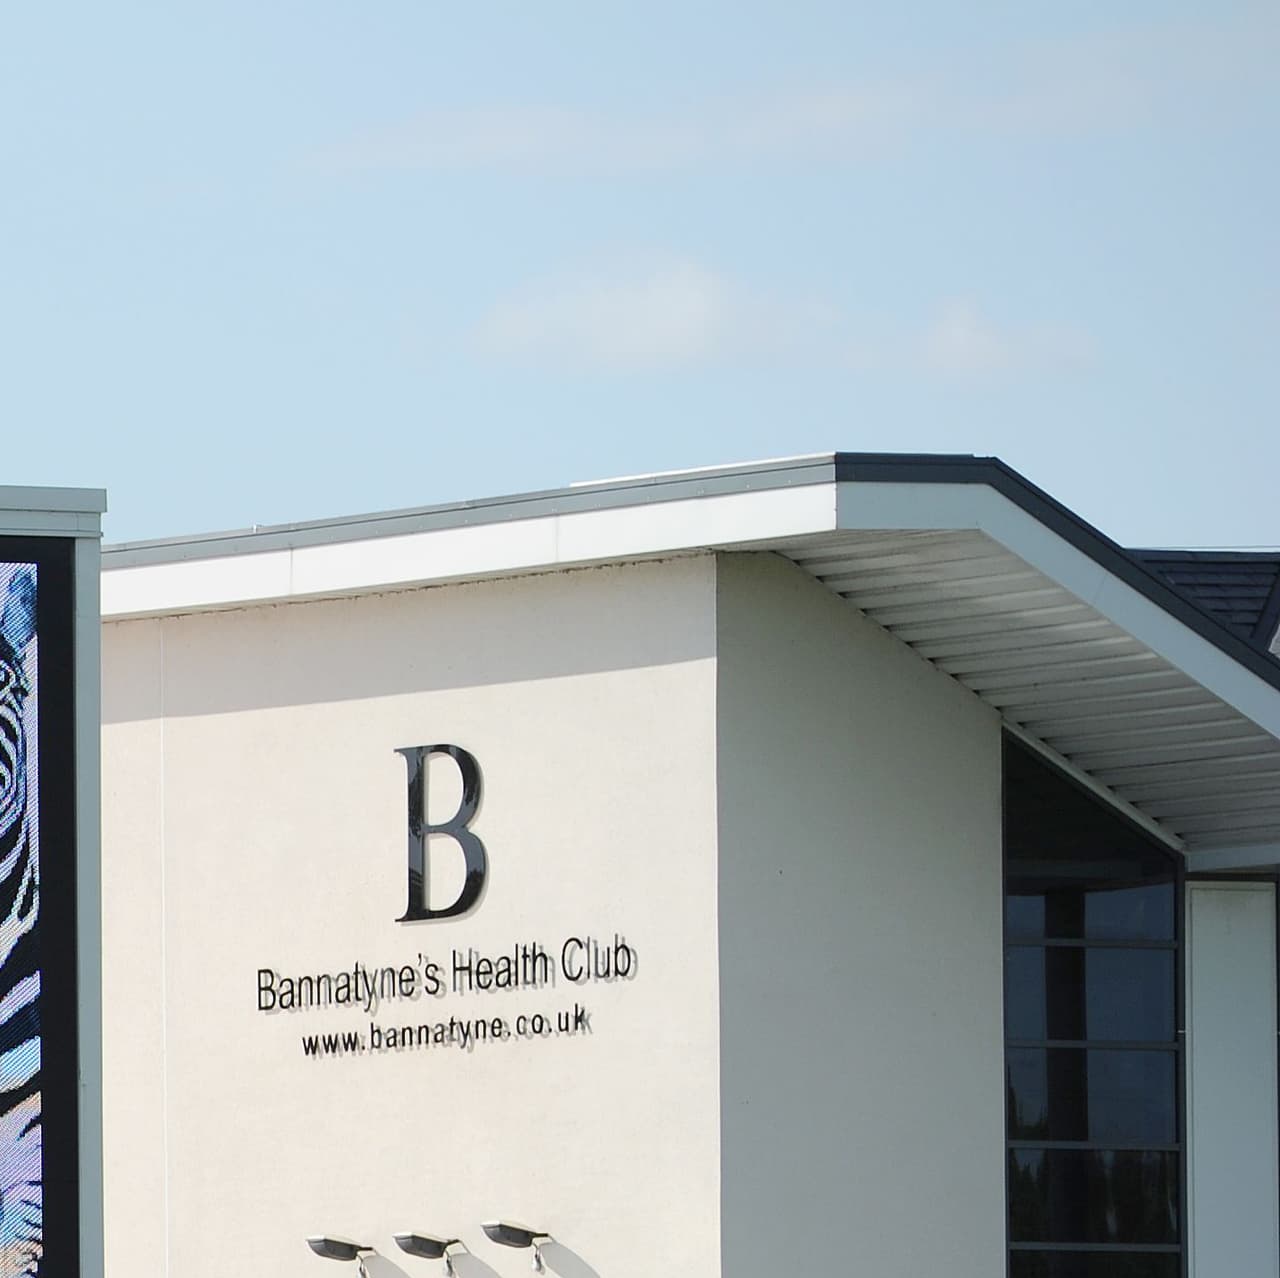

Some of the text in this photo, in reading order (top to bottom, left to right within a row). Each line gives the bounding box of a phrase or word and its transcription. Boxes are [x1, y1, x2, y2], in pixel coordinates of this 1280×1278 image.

[394, 744, 487, 923] B
[257, 933, 633, 1013] Bannatyne's Health Club
[302, 1004, 586, 1057] www.bannatyne.co.uk
